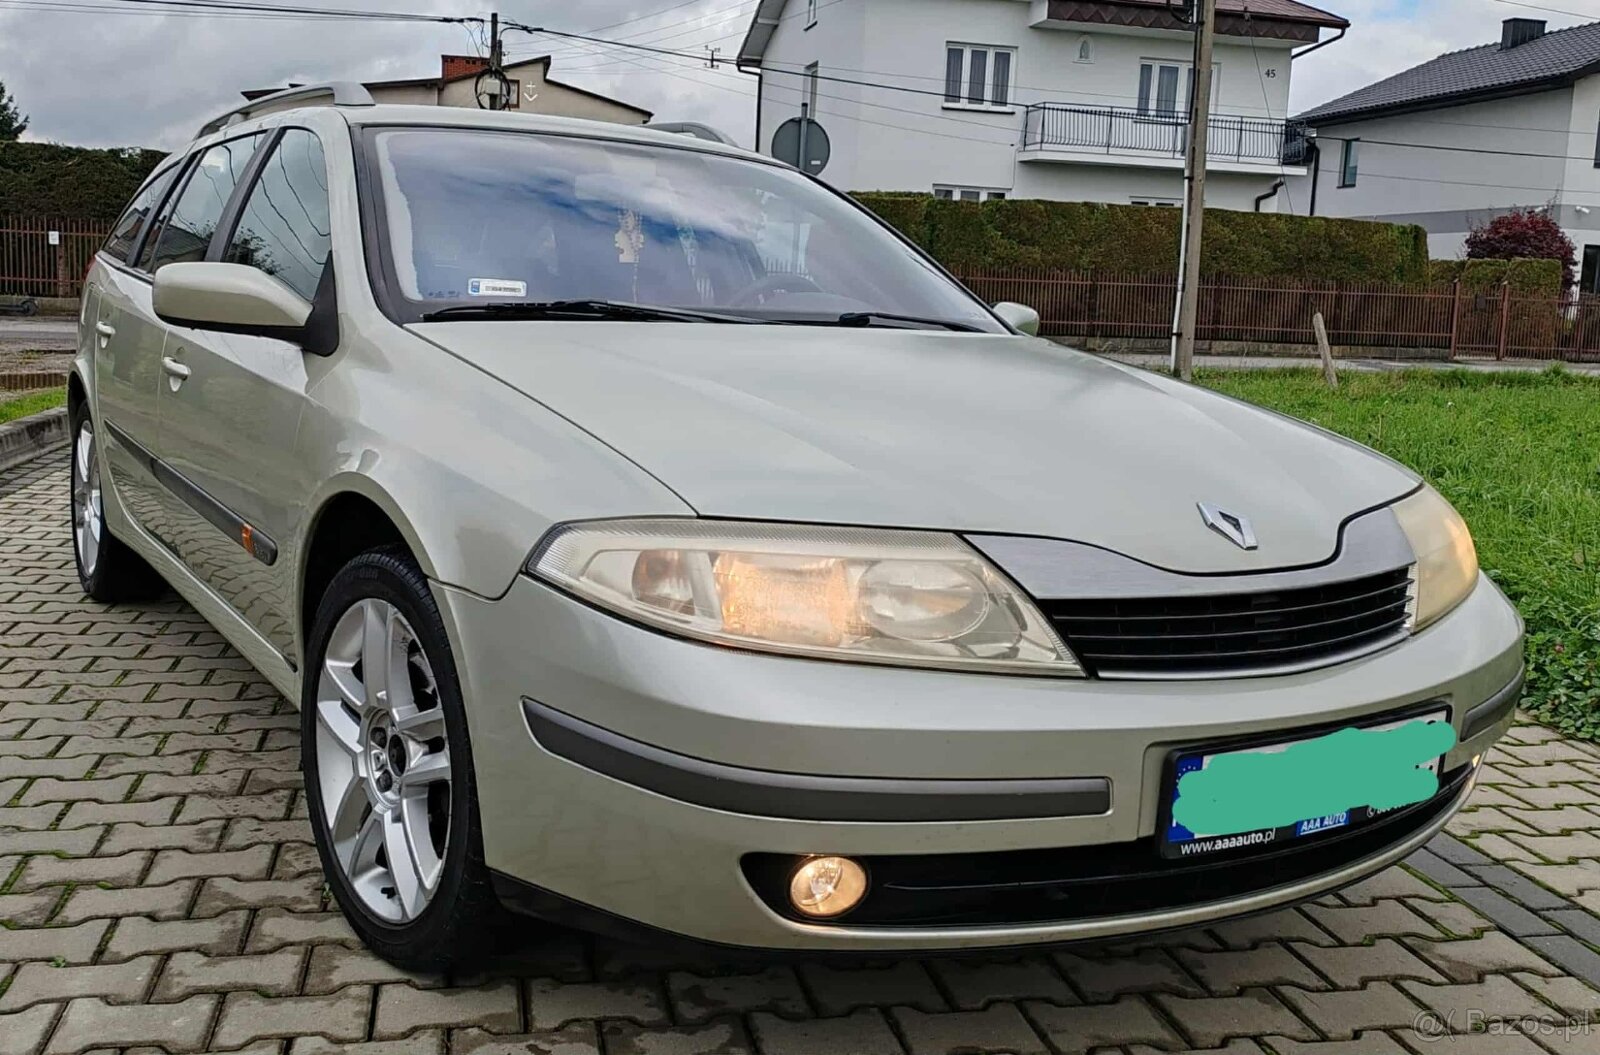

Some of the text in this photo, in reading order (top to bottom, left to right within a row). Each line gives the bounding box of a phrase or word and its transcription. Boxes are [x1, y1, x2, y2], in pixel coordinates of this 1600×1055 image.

[1265, 69, 1276, 78] 45
[1300, 811, 1347, 832] AAA AUTO
[1180, 827, 1276, 855] www.aaaauto.pl
